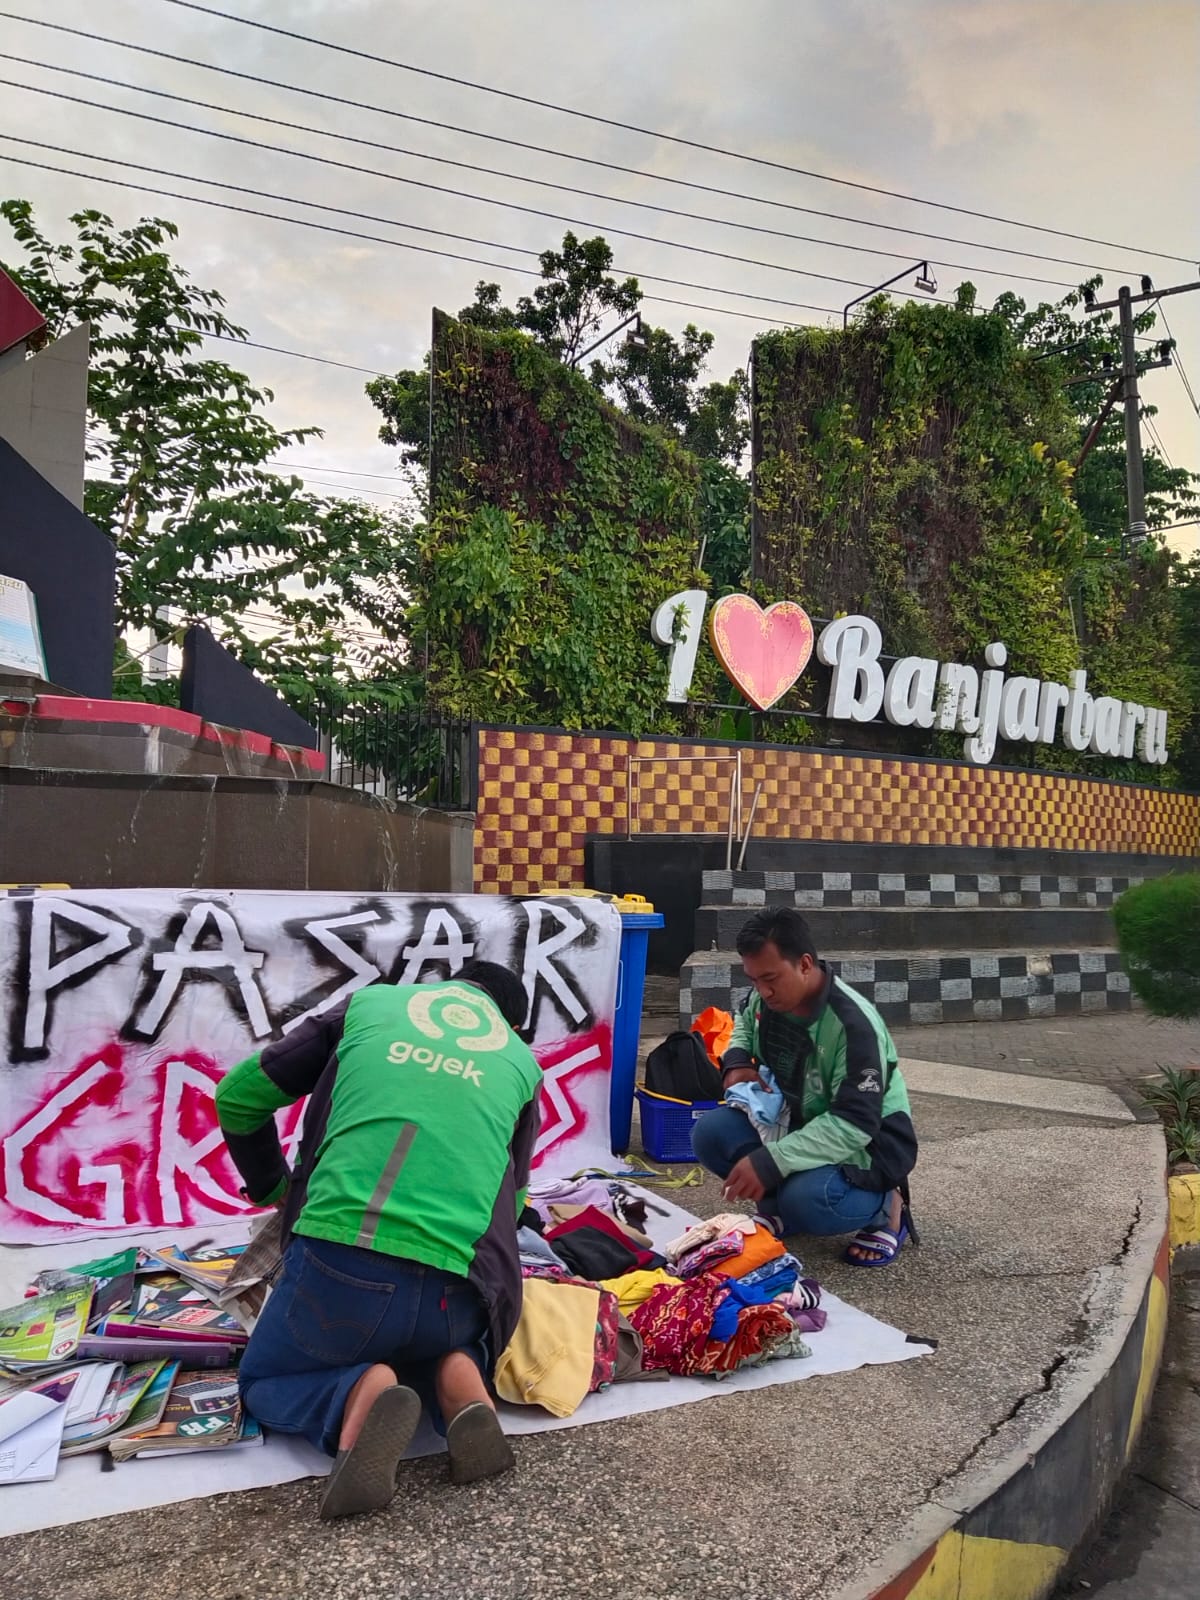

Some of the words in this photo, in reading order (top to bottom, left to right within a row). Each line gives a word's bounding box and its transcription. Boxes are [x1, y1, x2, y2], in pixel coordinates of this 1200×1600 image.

[651, 589, 708, 702] I
[817, 615, 1168, 765] Banjarbaru
[22, 896, 590, 1050] PASAR
[5, 1043, 602, 1225] GRS
[386, 1041, 486, 1088] gojek
